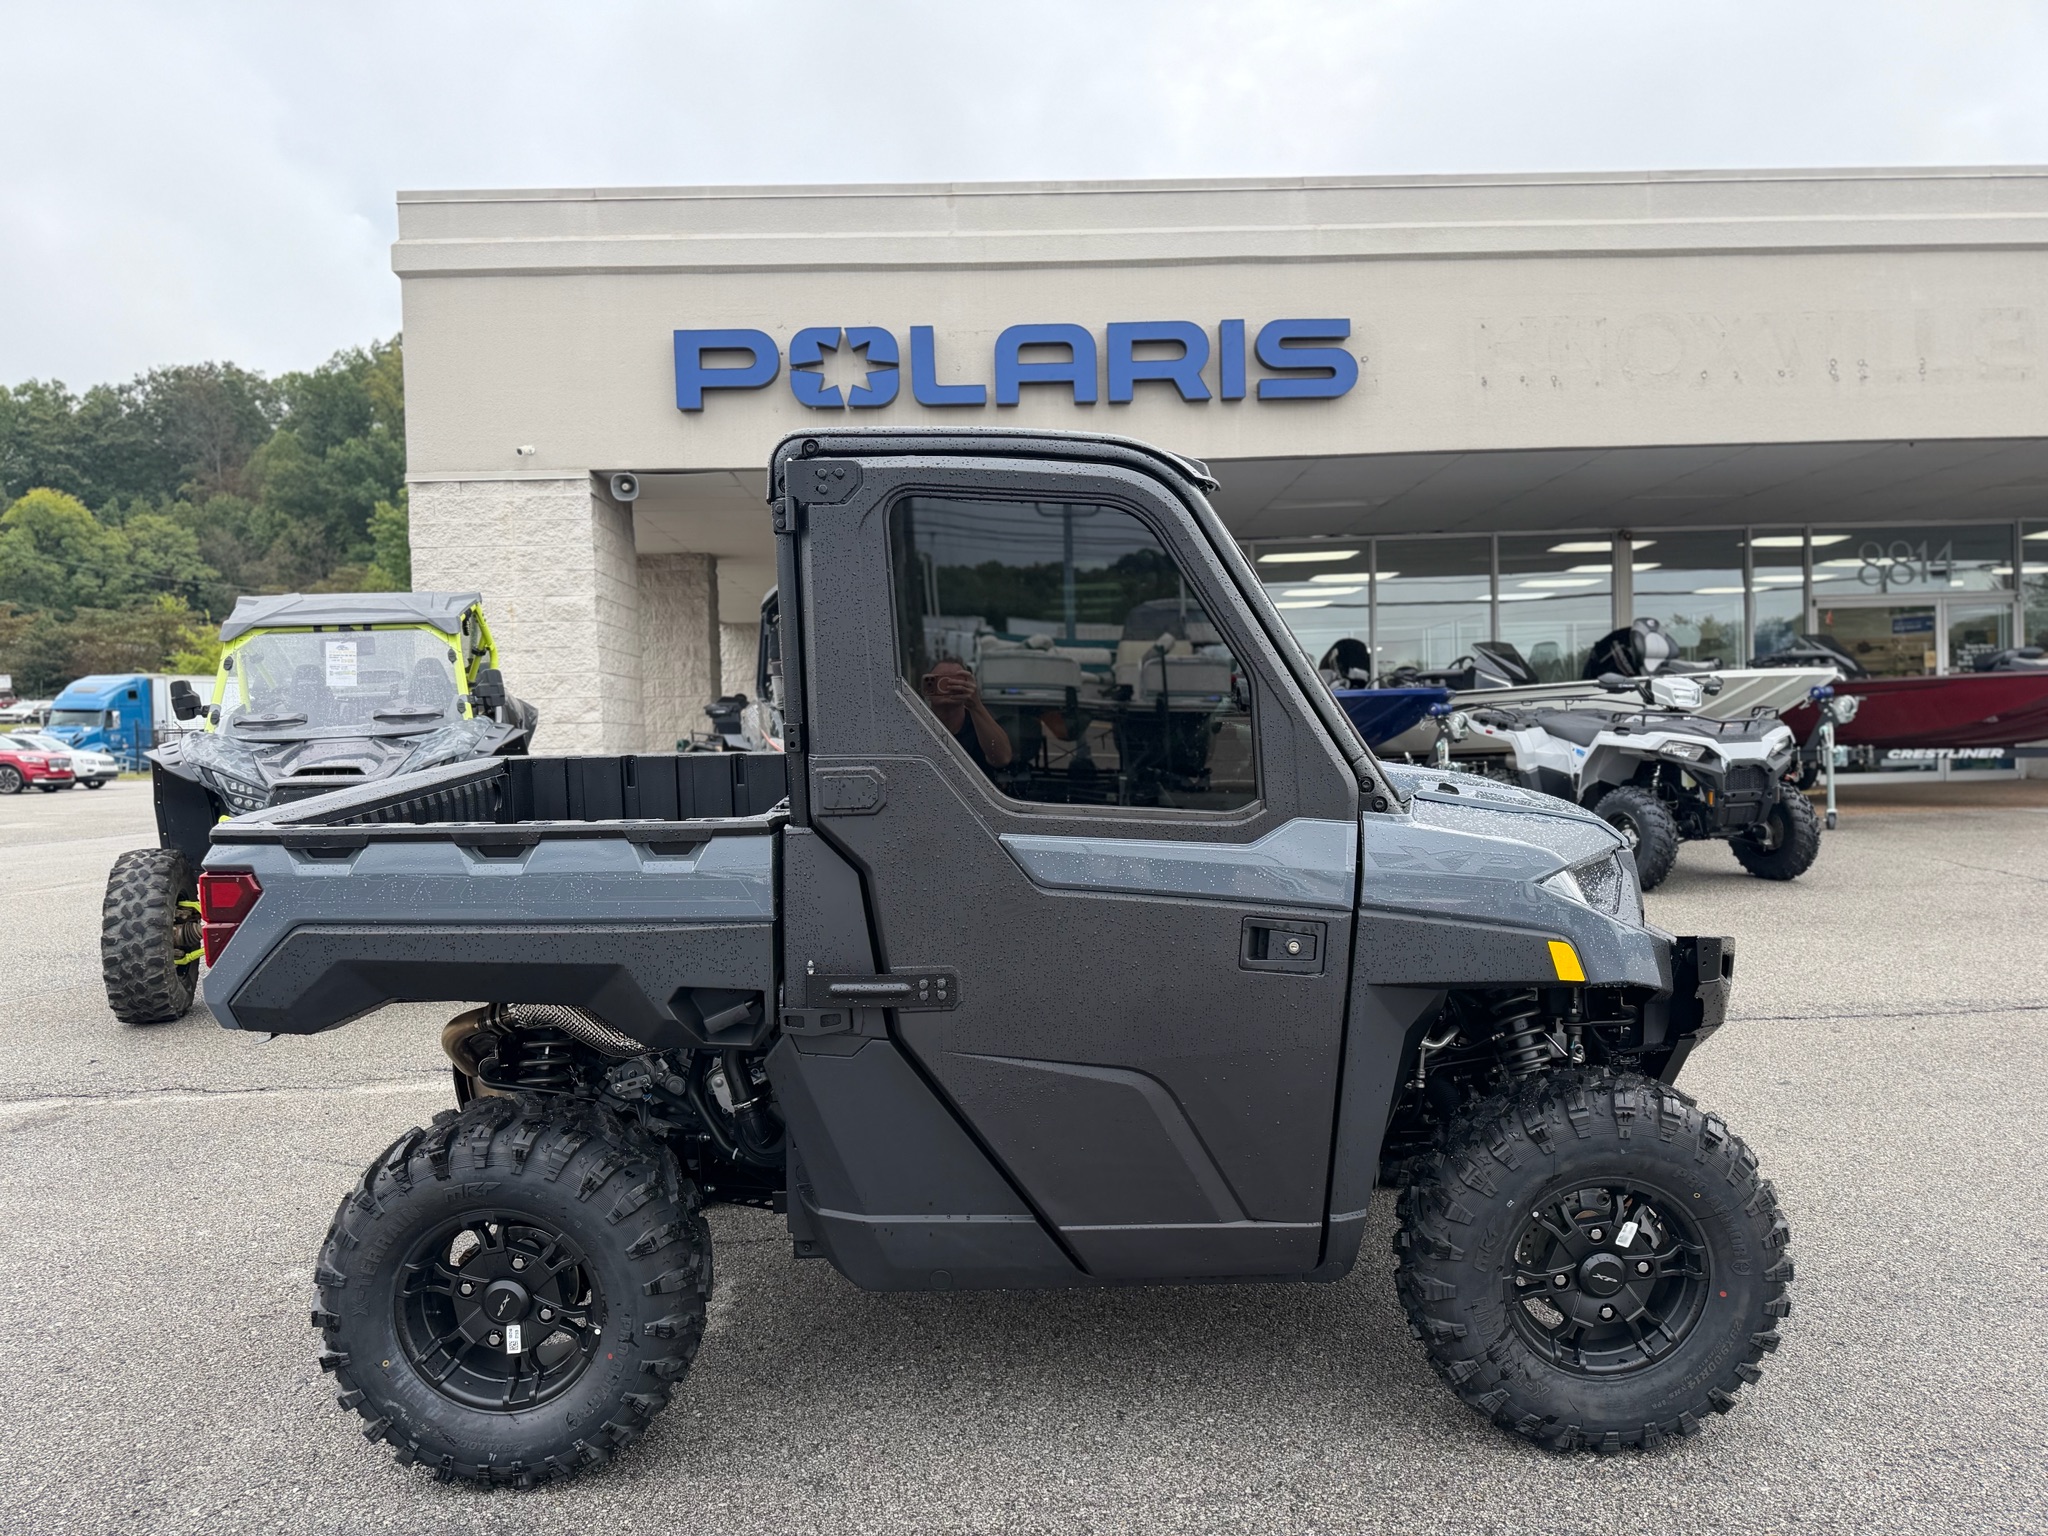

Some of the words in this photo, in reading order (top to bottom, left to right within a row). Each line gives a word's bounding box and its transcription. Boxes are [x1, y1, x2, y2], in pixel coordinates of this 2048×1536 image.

[673, 318, 1360, 412] POLARIS
[1857, 540, 1956, 586] 8814
[1887, 748, 2005, 760] CRESTLINER
[1672, 1166, 1709, 1191] PRO
[1705, 1194, 1748, 1258] ARMOR
[352, 1204, 423, 1318] X-TERRAIN
[1471, 1296, 1551, 1404] X-TERRAIN
[1687, 1319, 1743, 1391] 29X9.00R14
